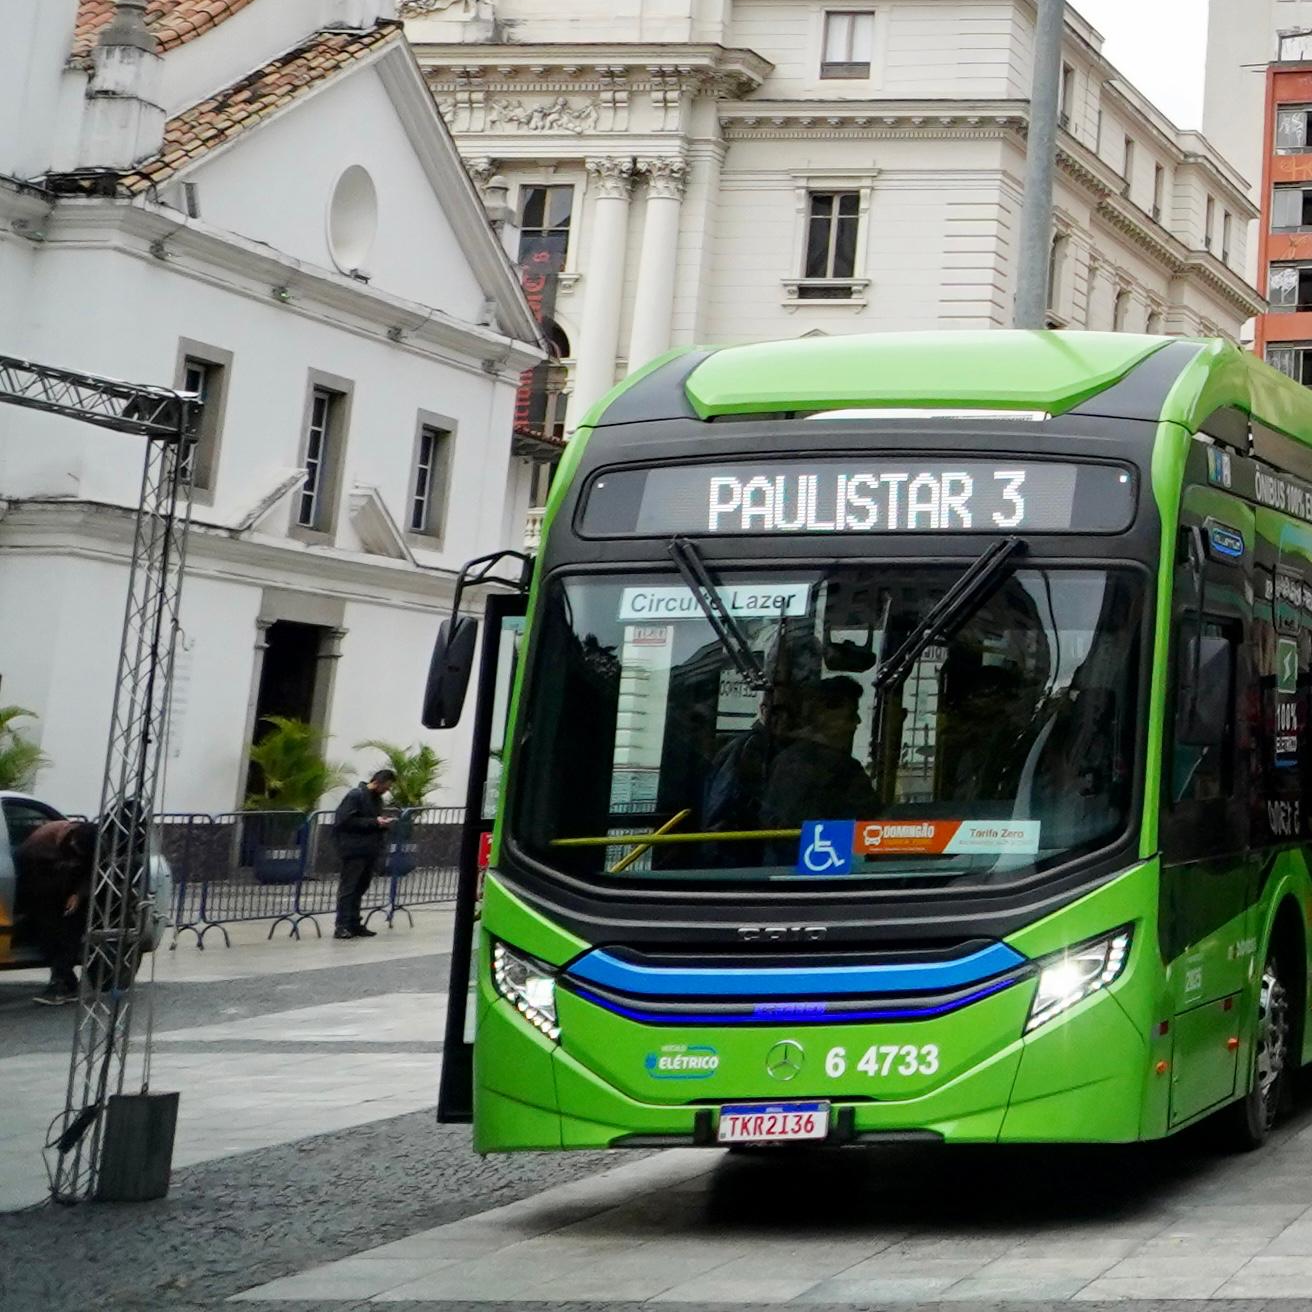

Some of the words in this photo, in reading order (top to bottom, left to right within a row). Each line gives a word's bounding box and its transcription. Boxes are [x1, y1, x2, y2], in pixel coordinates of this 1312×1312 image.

[708, 472, 974, 531] PAULISTAR
[992, 470, 1026, 528] 3
[731, 590, 797, 610] Lazer
[969, 827, 999, 839] Tarifa
[1001, 827, 1025, 839] Zero
[657, 1052, 720, 1071] ELÉTRICO
[824, 1045, 847, 1079] 6
[856, 1043, 940, 1077] 4733
[727, 1112, 816, 1137] TKR2I36
